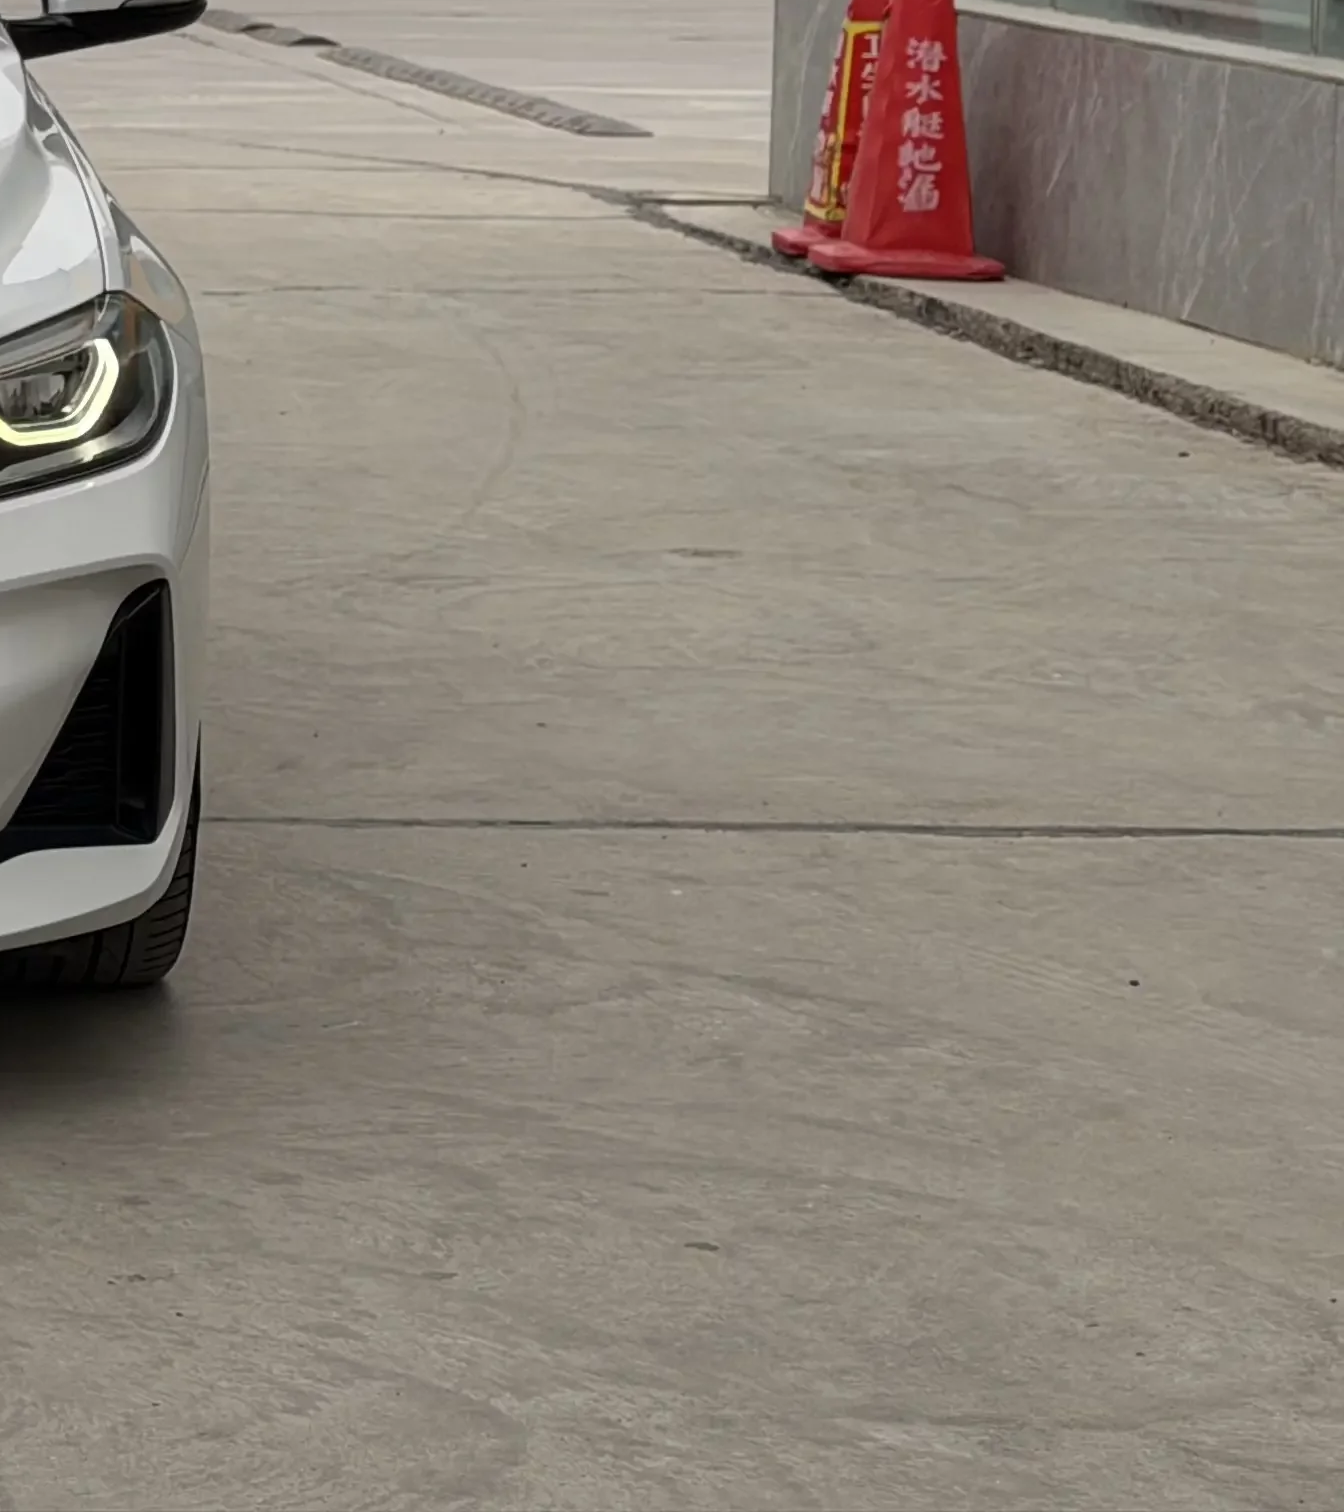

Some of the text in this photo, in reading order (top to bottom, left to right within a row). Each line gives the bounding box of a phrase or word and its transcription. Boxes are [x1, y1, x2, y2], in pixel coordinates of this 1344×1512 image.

[896, 37, 948, 213] 潜水艇地漏
